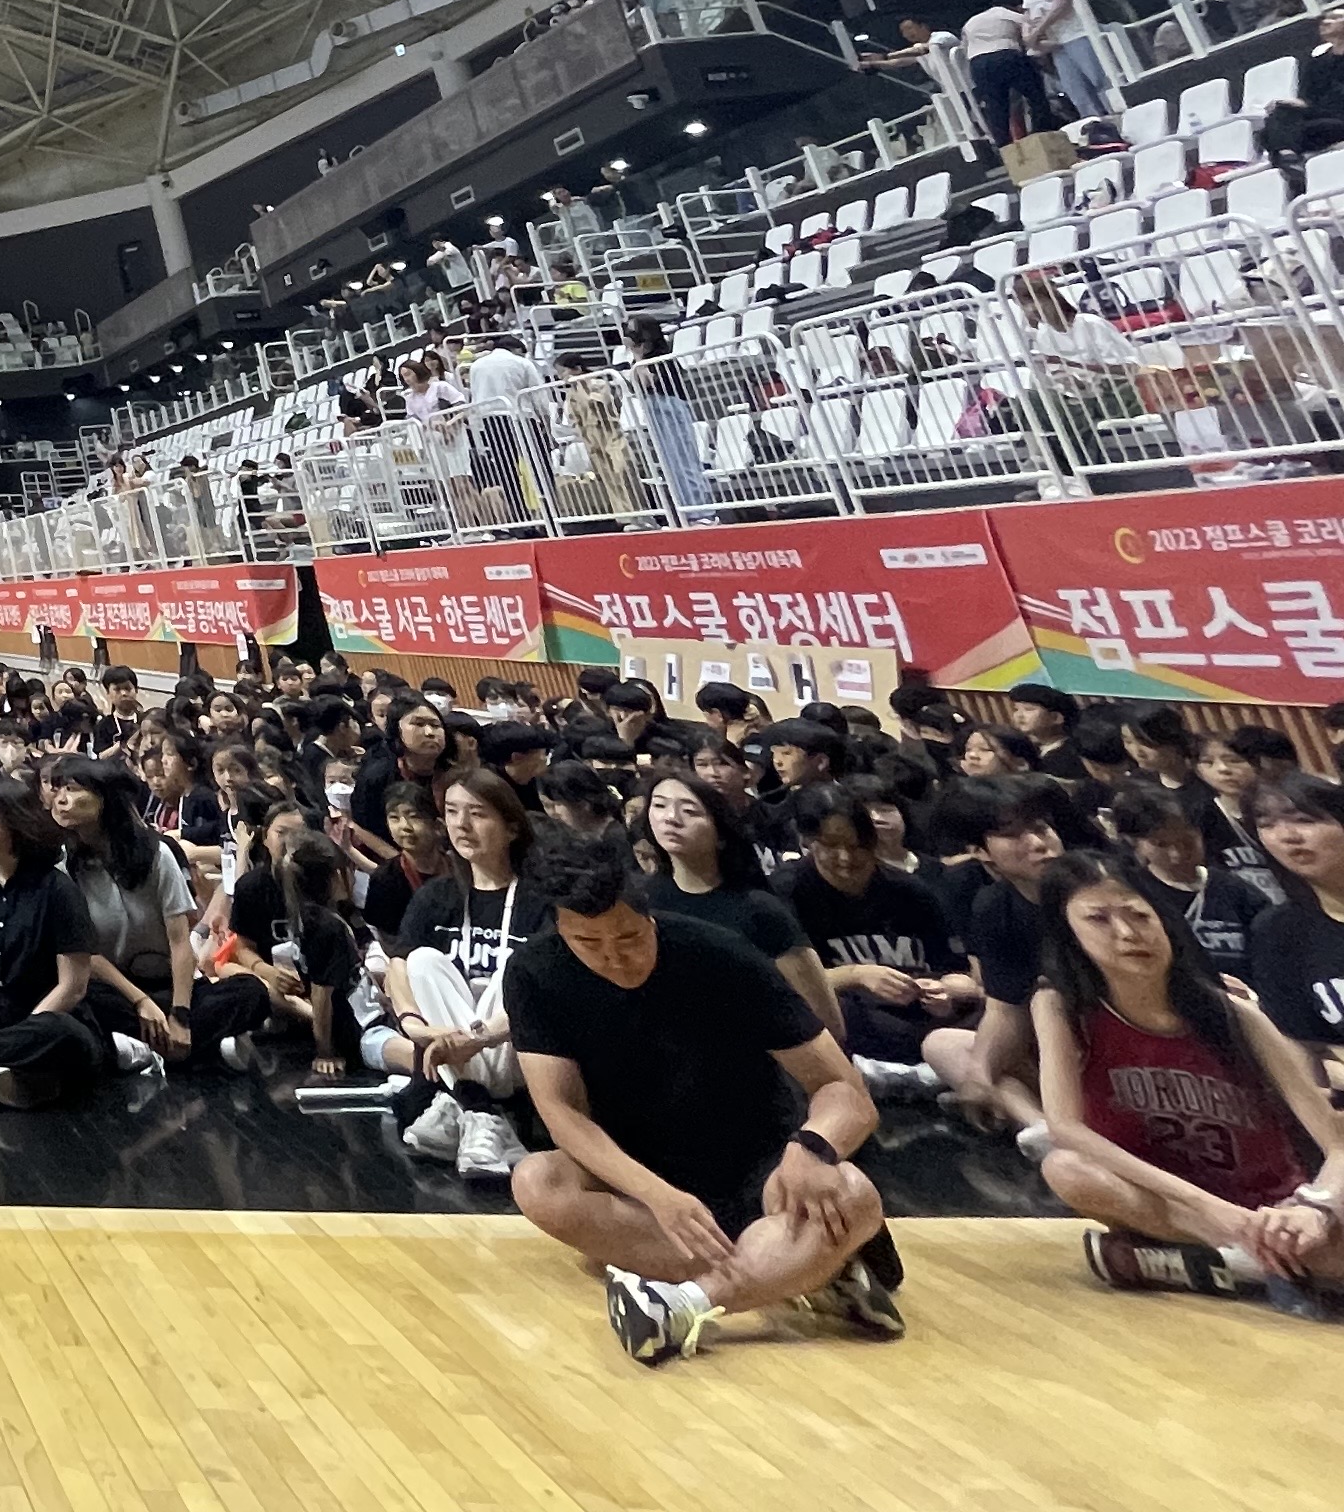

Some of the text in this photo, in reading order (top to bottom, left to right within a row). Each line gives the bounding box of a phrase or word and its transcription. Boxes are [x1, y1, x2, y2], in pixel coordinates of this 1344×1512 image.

[1148, 517, 1344, 552] 2023 점프스쿨 코리
[328, 597, 396, 642] 점프스쿨
[592, 591, 914, 663] 점프스쿨 화정센터
[1056, 580, 1344, 678] 점프스쿨
